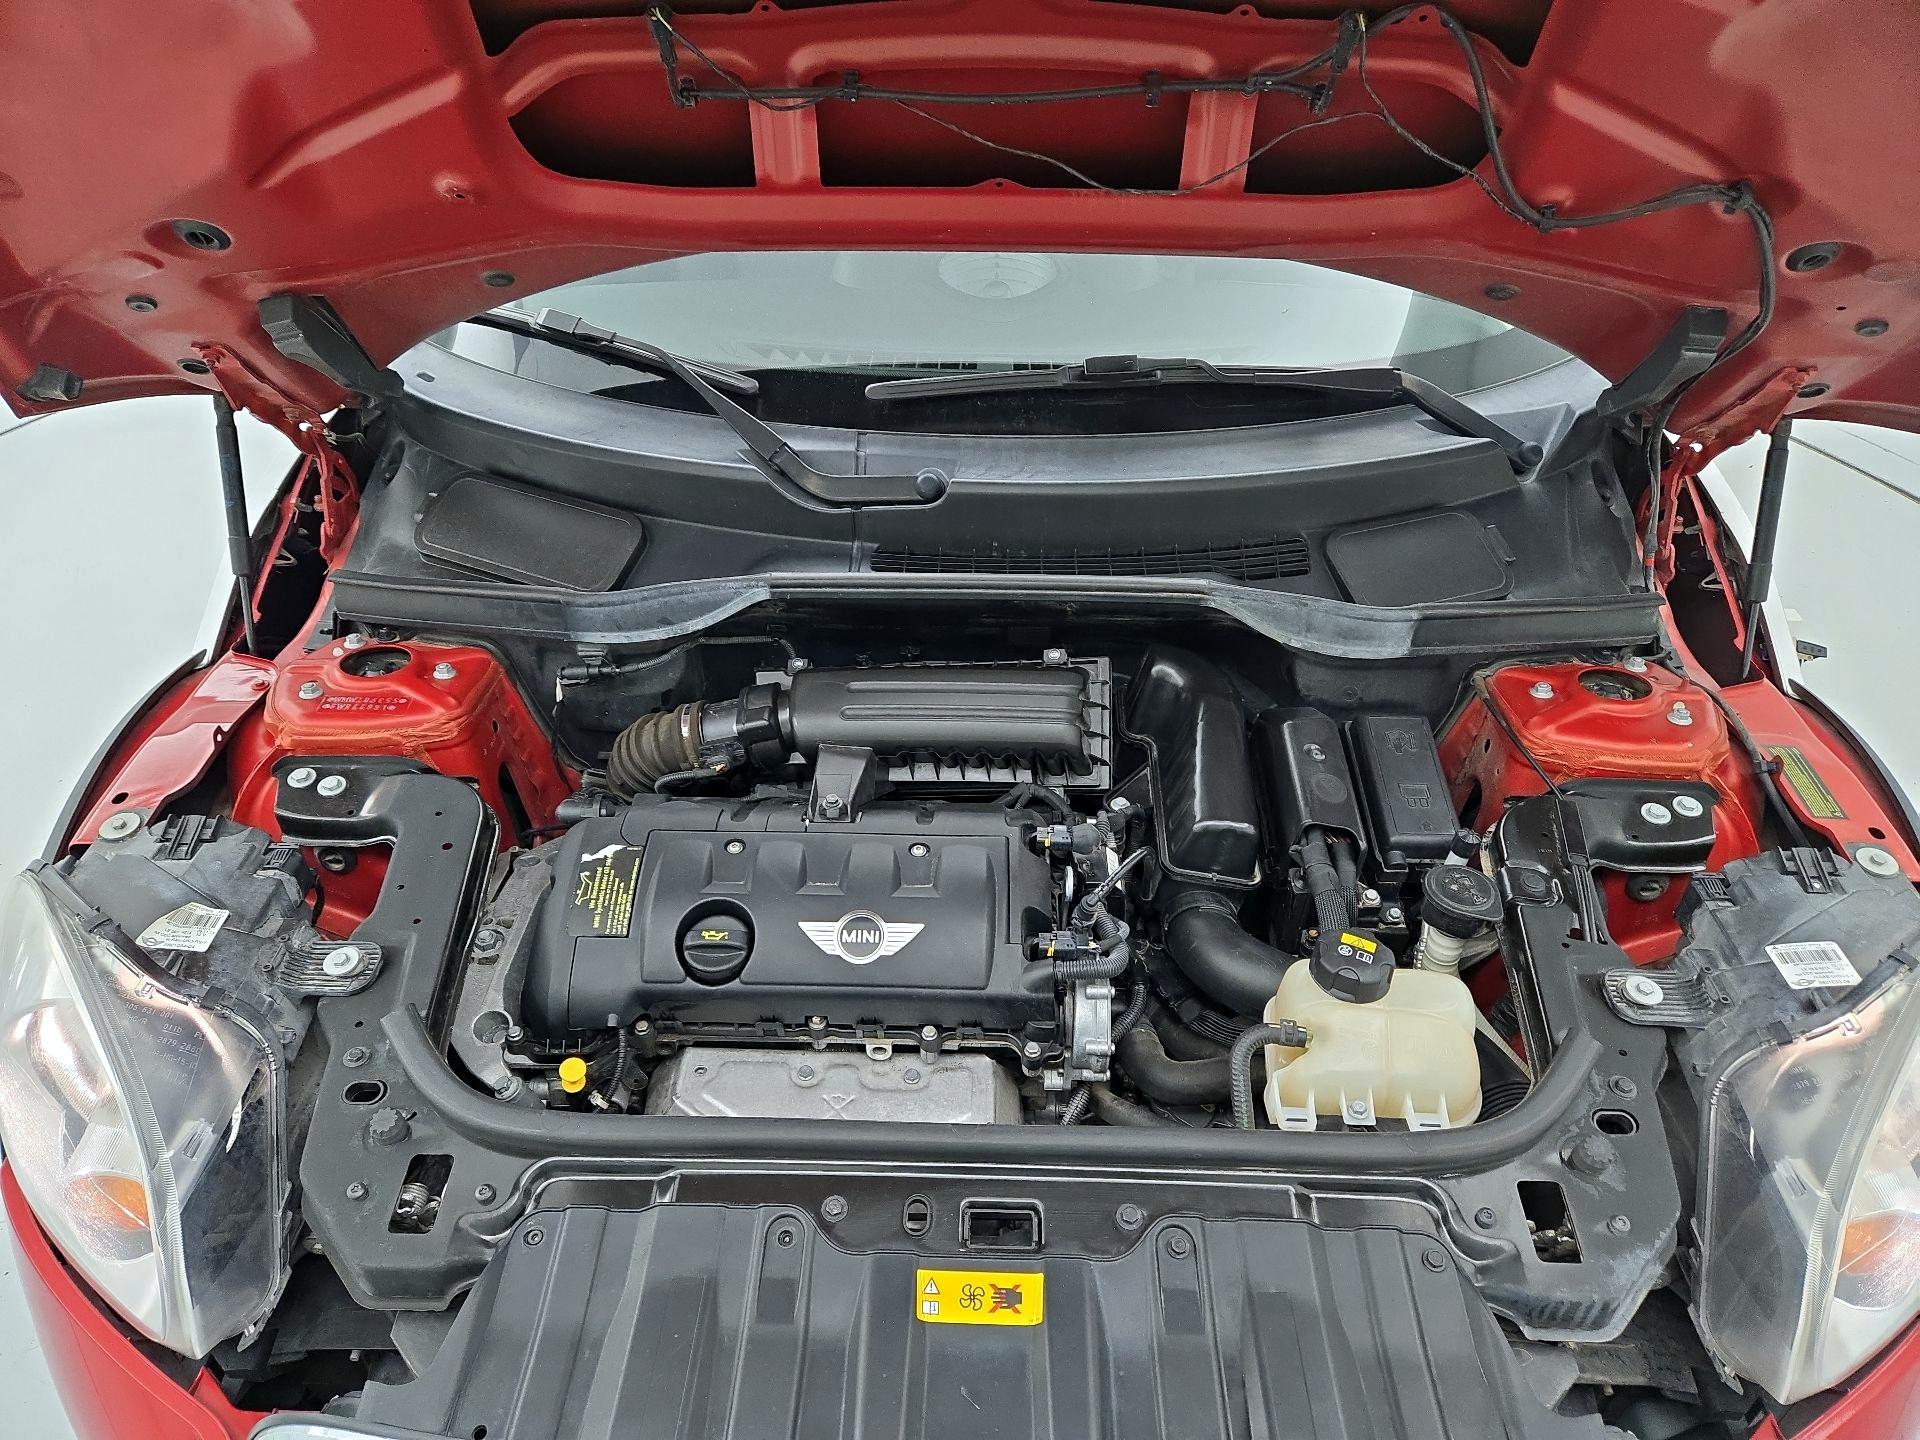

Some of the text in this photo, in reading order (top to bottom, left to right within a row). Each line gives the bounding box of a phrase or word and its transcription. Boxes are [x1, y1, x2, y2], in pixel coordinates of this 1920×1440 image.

[590, 866, 602, 898] Recommend
[599, 873, 608, 889] Motor
[594, 888, 606, 914] Synthetic
[841, 929, 880, 943] MINI
